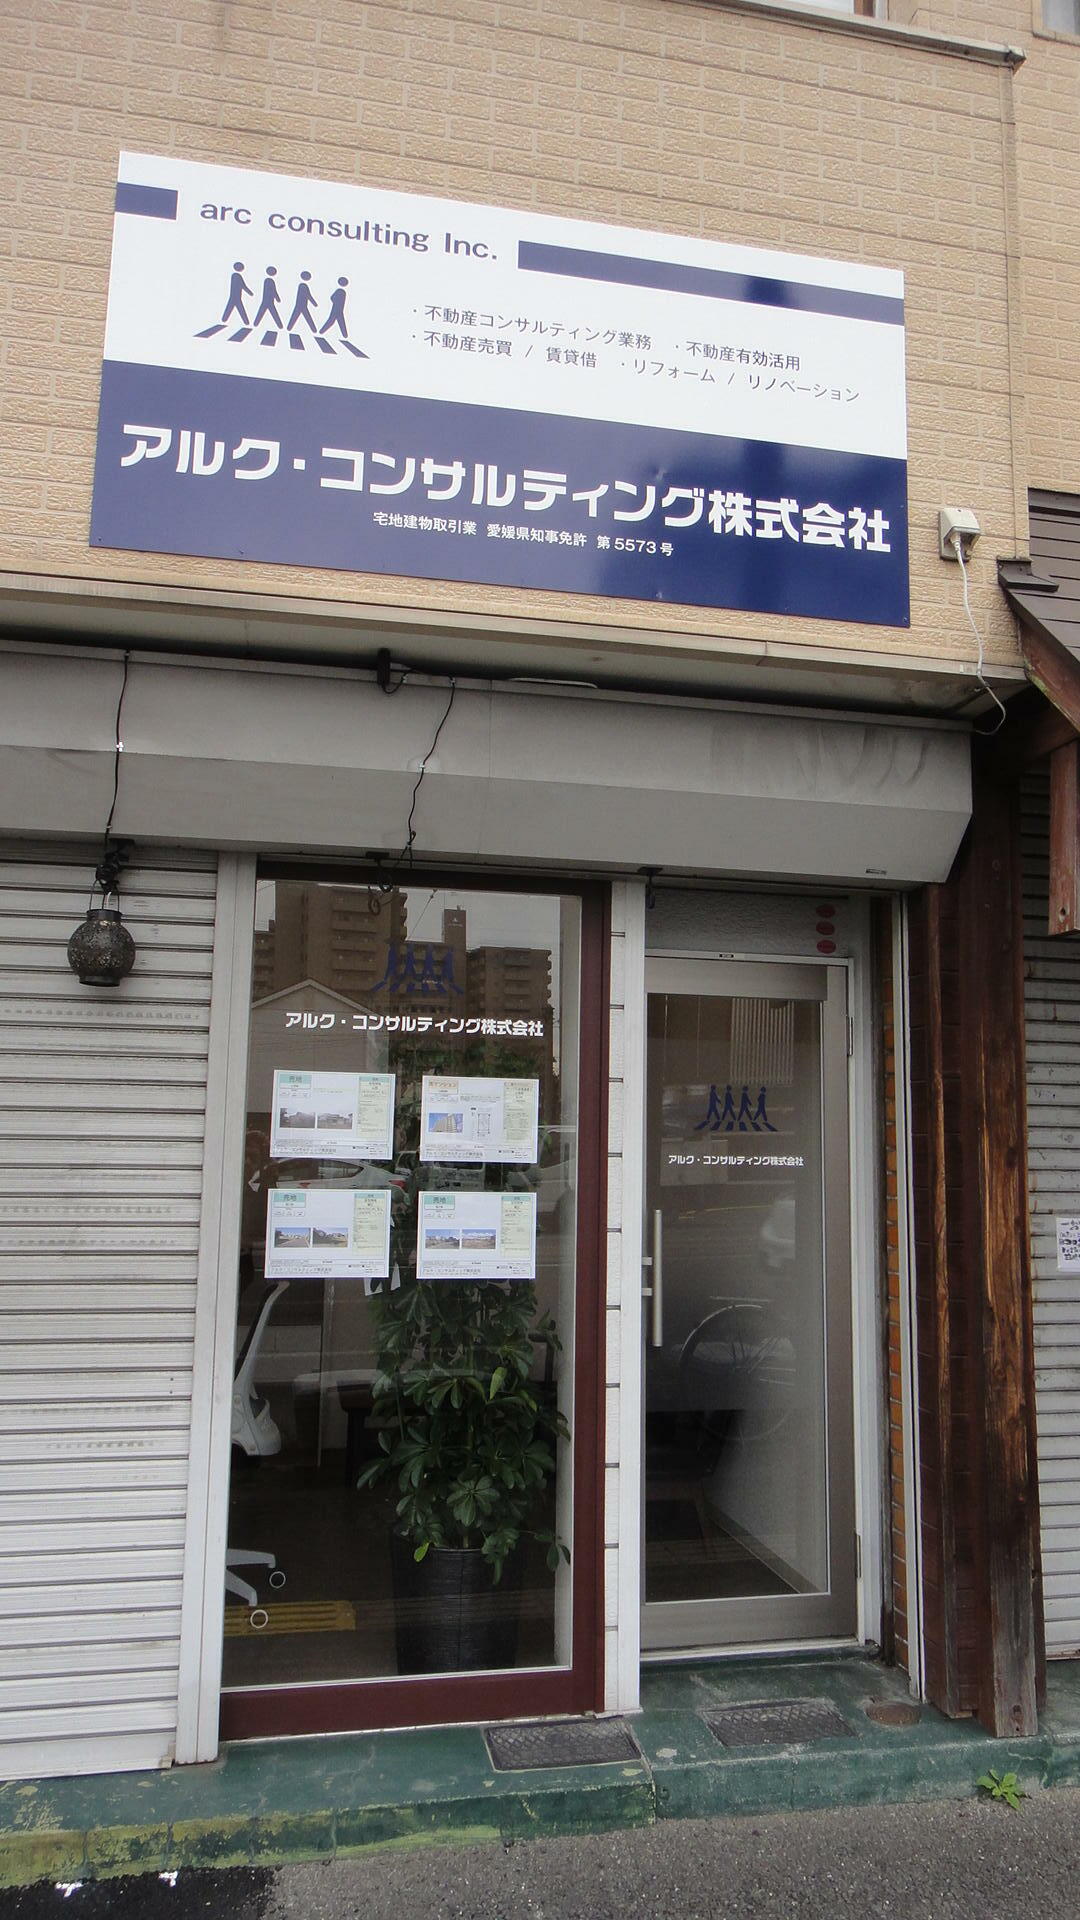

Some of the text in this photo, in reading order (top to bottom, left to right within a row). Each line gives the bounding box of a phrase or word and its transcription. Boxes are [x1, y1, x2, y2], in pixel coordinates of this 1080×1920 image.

[200, 201, 498, 260] arc consulting Inc.
[119, 423, 892, 553] アルク・コンサルティング株式会社
[373, 511, 477, 536] 宅地建物取引業
[486, 523, 588, 548] 愛媛県知事免許
[285, 1012, 544, 1037] アルク・コンサルティング株式会社
[668, 1155, 804, 1167] アルク・コンサルティング株式会社
